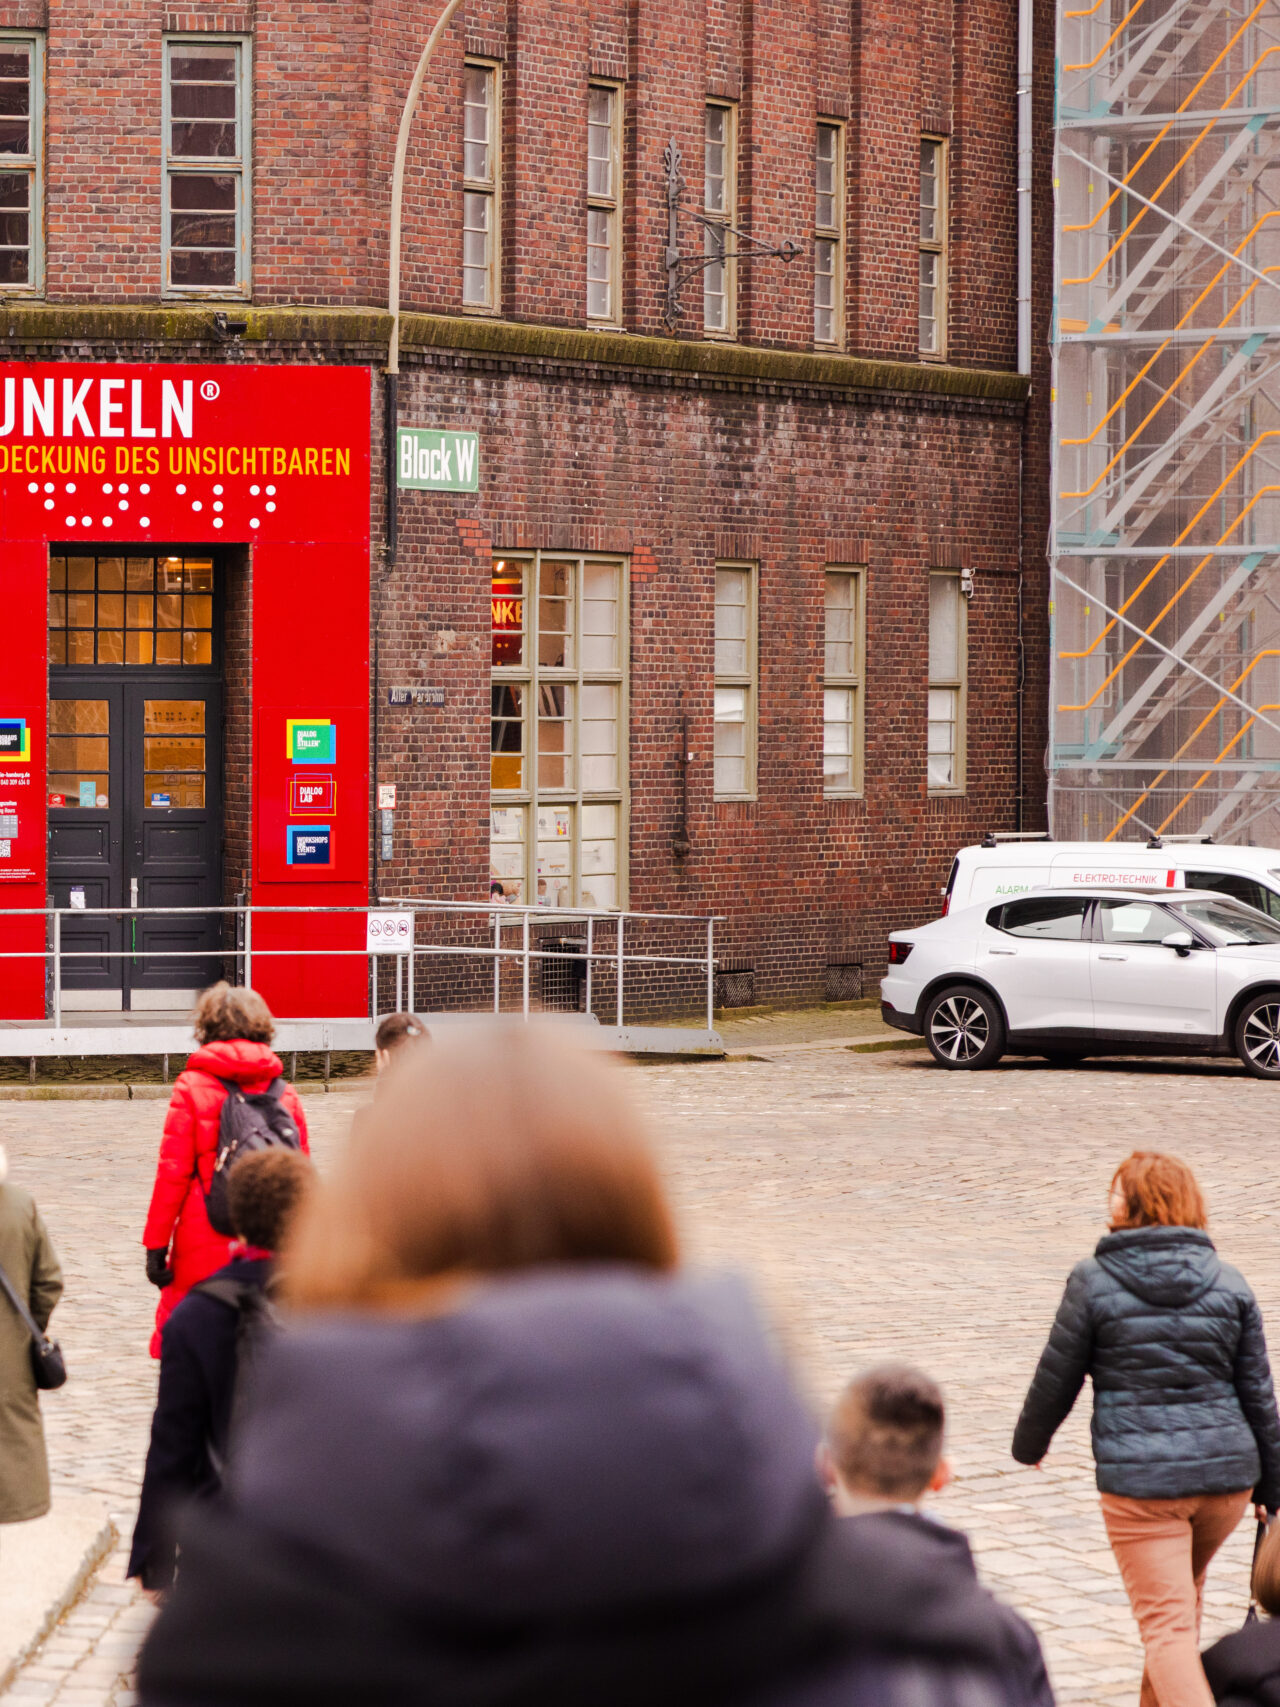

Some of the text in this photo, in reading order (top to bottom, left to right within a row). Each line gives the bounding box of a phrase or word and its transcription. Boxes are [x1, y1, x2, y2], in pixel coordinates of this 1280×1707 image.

[115, 446, 160, 475] DES
[169, 447, 350, 476] UNSICHTBAREN
[401, 434, 476, 482] Block W
[299, 786, 323, 795] DIALOG
[300, 795, 313, 803] LAB
[296, 836, 329, 845] WORKSHOPS
[296, 846, 316, 854] EVENTS
[1073, 872, 1157, 885] ELEKTRO-TECHNIK
[995, 884, 1030, 896] ALARM
